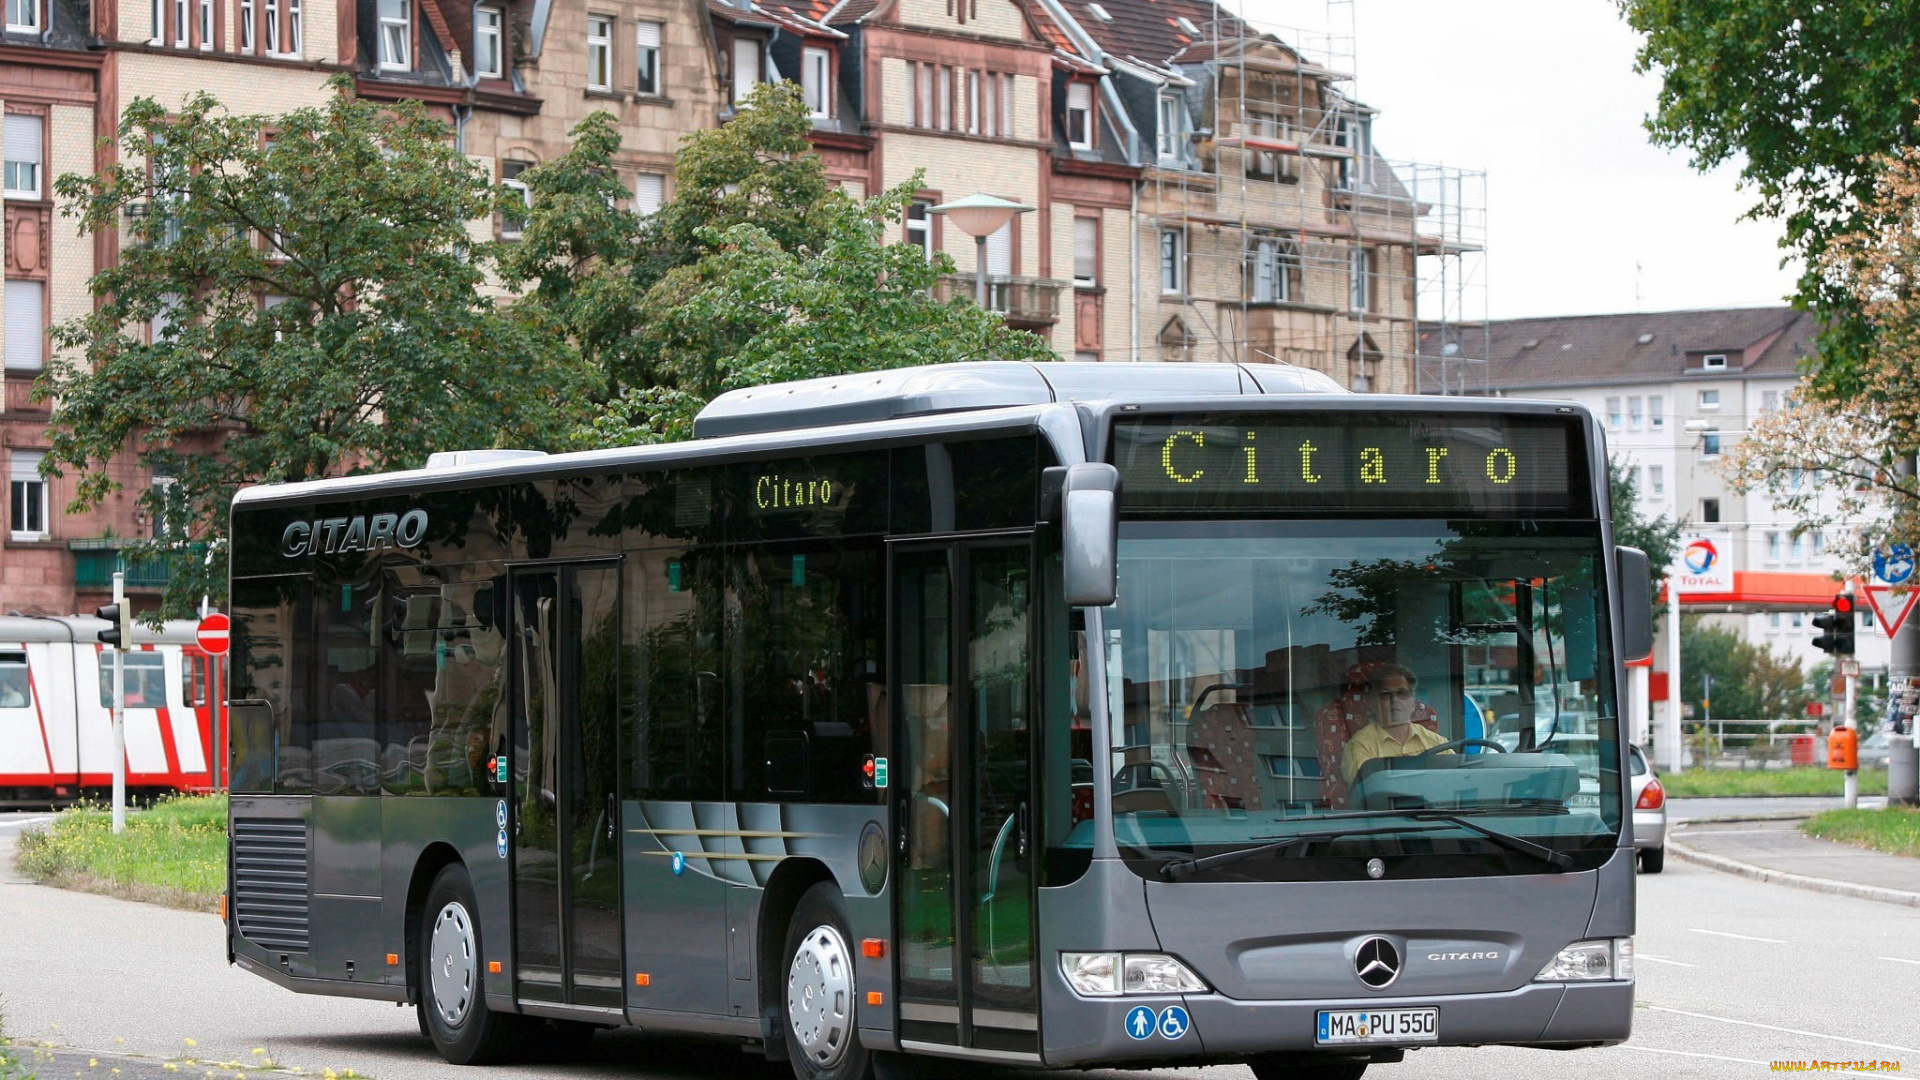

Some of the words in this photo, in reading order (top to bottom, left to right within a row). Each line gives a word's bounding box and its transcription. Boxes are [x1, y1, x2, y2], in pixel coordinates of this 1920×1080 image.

[1161, 430, 1517, 484] Citaro
[756, 474, 831, 509] Citaro
[281, 507, 429, 558] CITARO
[1680, 575, 1724, 585] TOTAL
[1427, 951, 1500, 961] CITARO
[1331, 1015, 1356, 1036] MA
[1370, 1013, 1394, 1035] PU
[1400, 1012, 1435, 1034] 550
